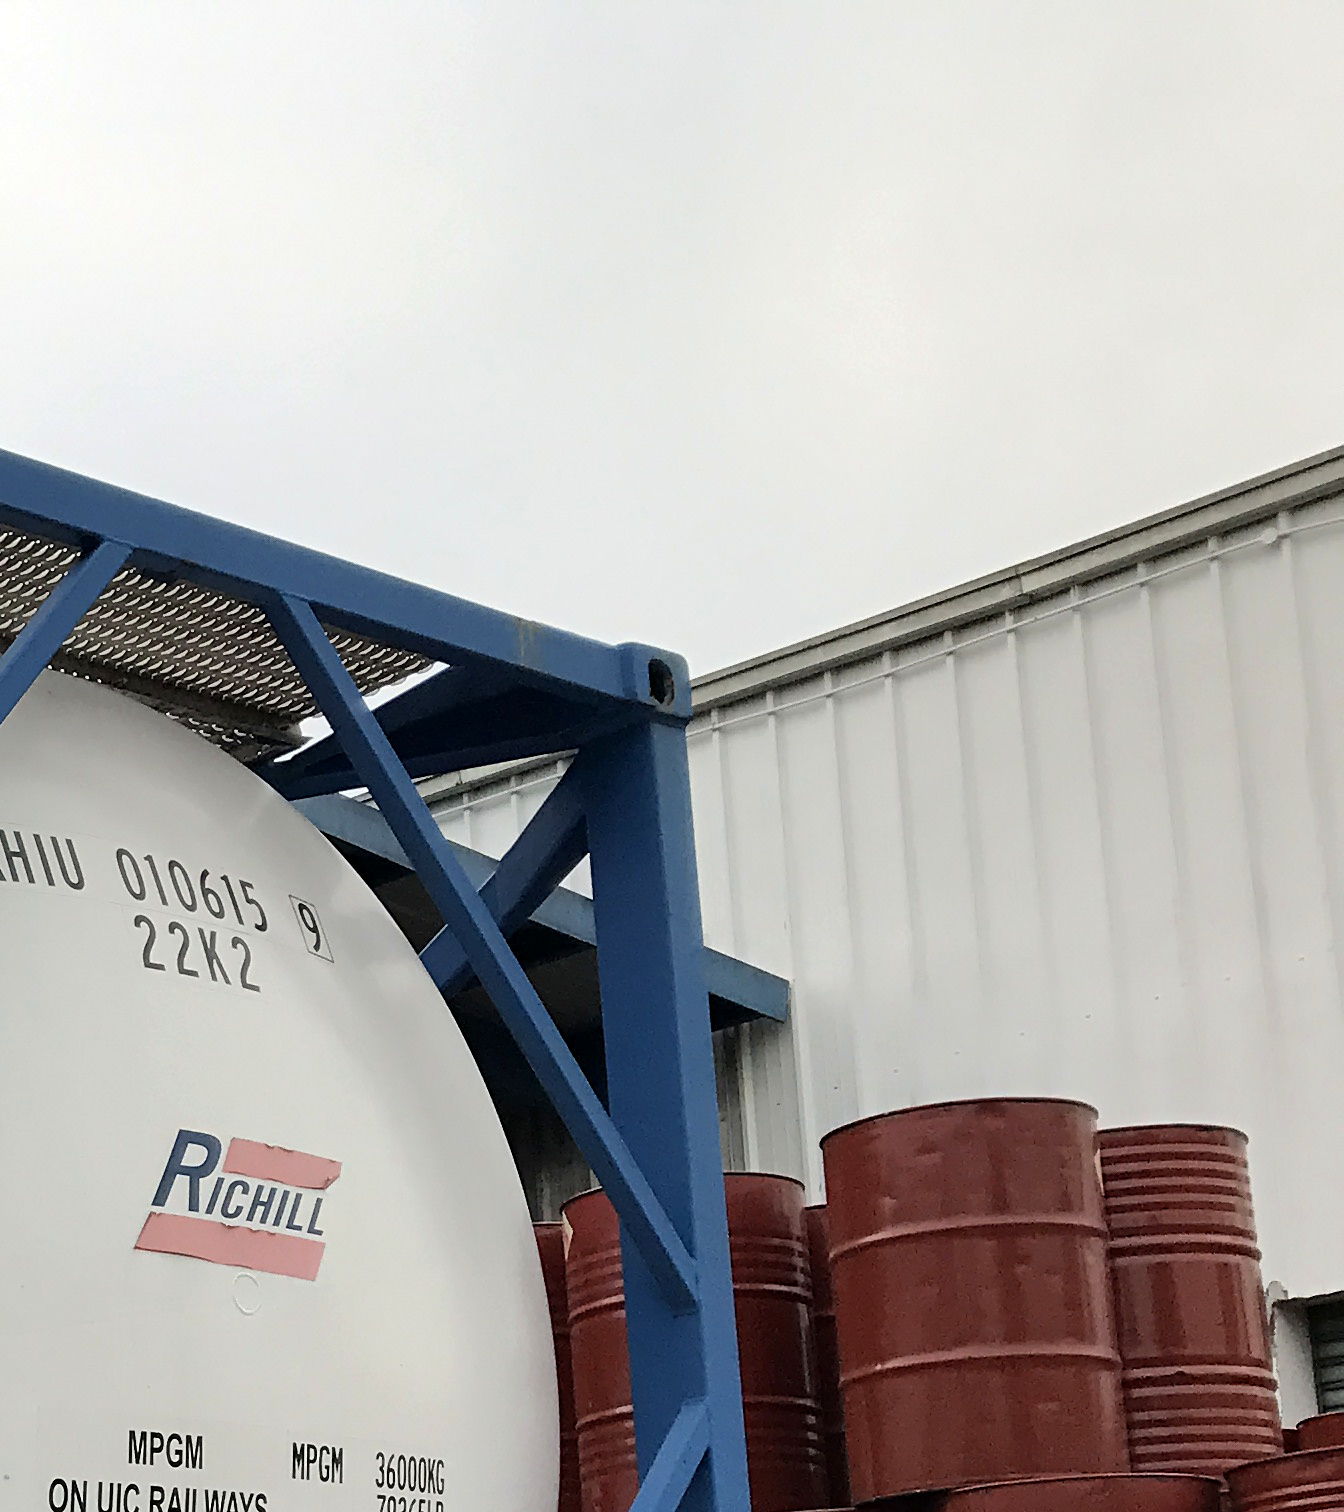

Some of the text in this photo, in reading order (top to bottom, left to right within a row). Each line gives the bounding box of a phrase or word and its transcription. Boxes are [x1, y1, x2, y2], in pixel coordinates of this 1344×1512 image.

[116, 847, 268, 932] 010615
[297, 902, 322, 953] 9
[133, 913, 262, 993] 22K2
[127, 1429, 204, 1471] MPGM
[292, 1441, 446, 1496] MPGM 36000KG
